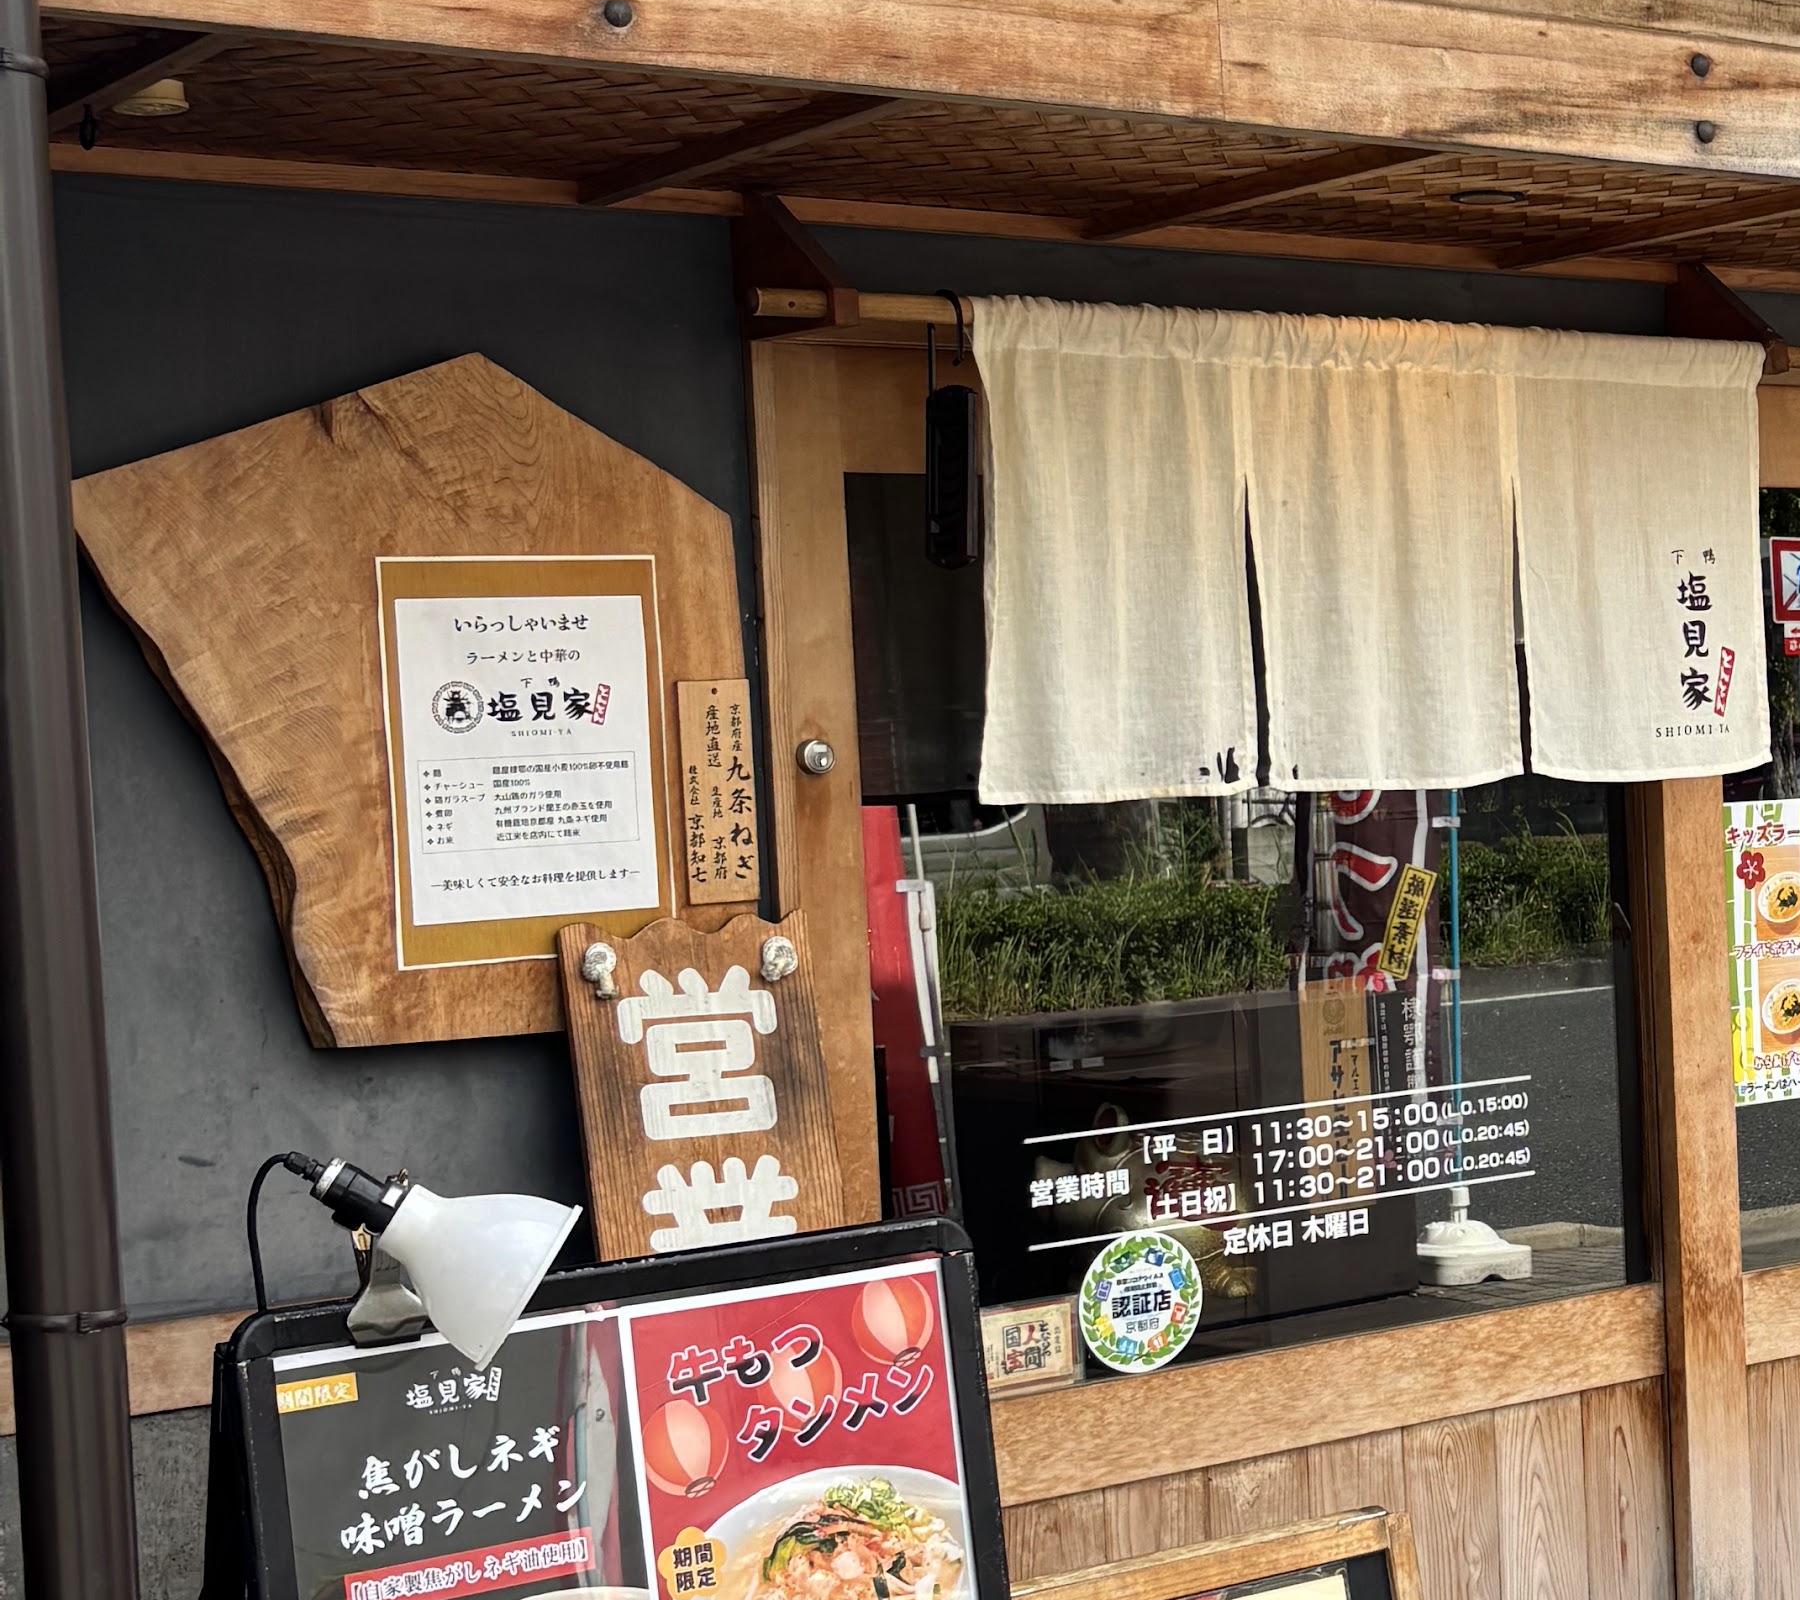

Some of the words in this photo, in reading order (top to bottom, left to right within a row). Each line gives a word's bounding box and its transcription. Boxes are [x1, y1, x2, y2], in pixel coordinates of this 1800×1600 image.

[1671, 547, 1717, 566] 下鴨
[455, 613, 589, 634] いらっしゃいませ
[1676, 571, 1713, 711] 塩見家
[467, 648, 581, 665] ラーメンと中華の
[487, 687, 594, 722] 塩見家
[705, 704, 722, 768] 産地直送
[729, 703, 743, 752] 京都府産
[1655, 724, 1731, 738] SHIOMI-YA
[688, 764, 701, 806] 株式会社
[726, 755, 755, 880] 九条ねぎ
[712, 836, 727, 880] 京都府
[1029, 1168, 1131, 1210] 営業時間
[1145, 1182, 1237, 1224] 【土日祝】
[1223, 1216, 1294, 1257] 定休日
[1302, 1208, 1371, 1243] 木曜日
[1112, 1290, 1171, 1319] 認証店
[1126, 1318, 1160, 1333] 京都府
[667, 1323, 824, 1406] 牛もつ
[278, 1381, 351, 1409] 期間限定
[406, 1373, 487, 1409] 塩見家
[737, 1363, 934, 1463] タンメン
[358, 1424, 562, 1500] 焦がしネギ
[341, 1480, 587, 1557] 味噌ラーメン
[672, 1541, 715, 1570] 期間
[676, 1565, 717, 1594] 限定
